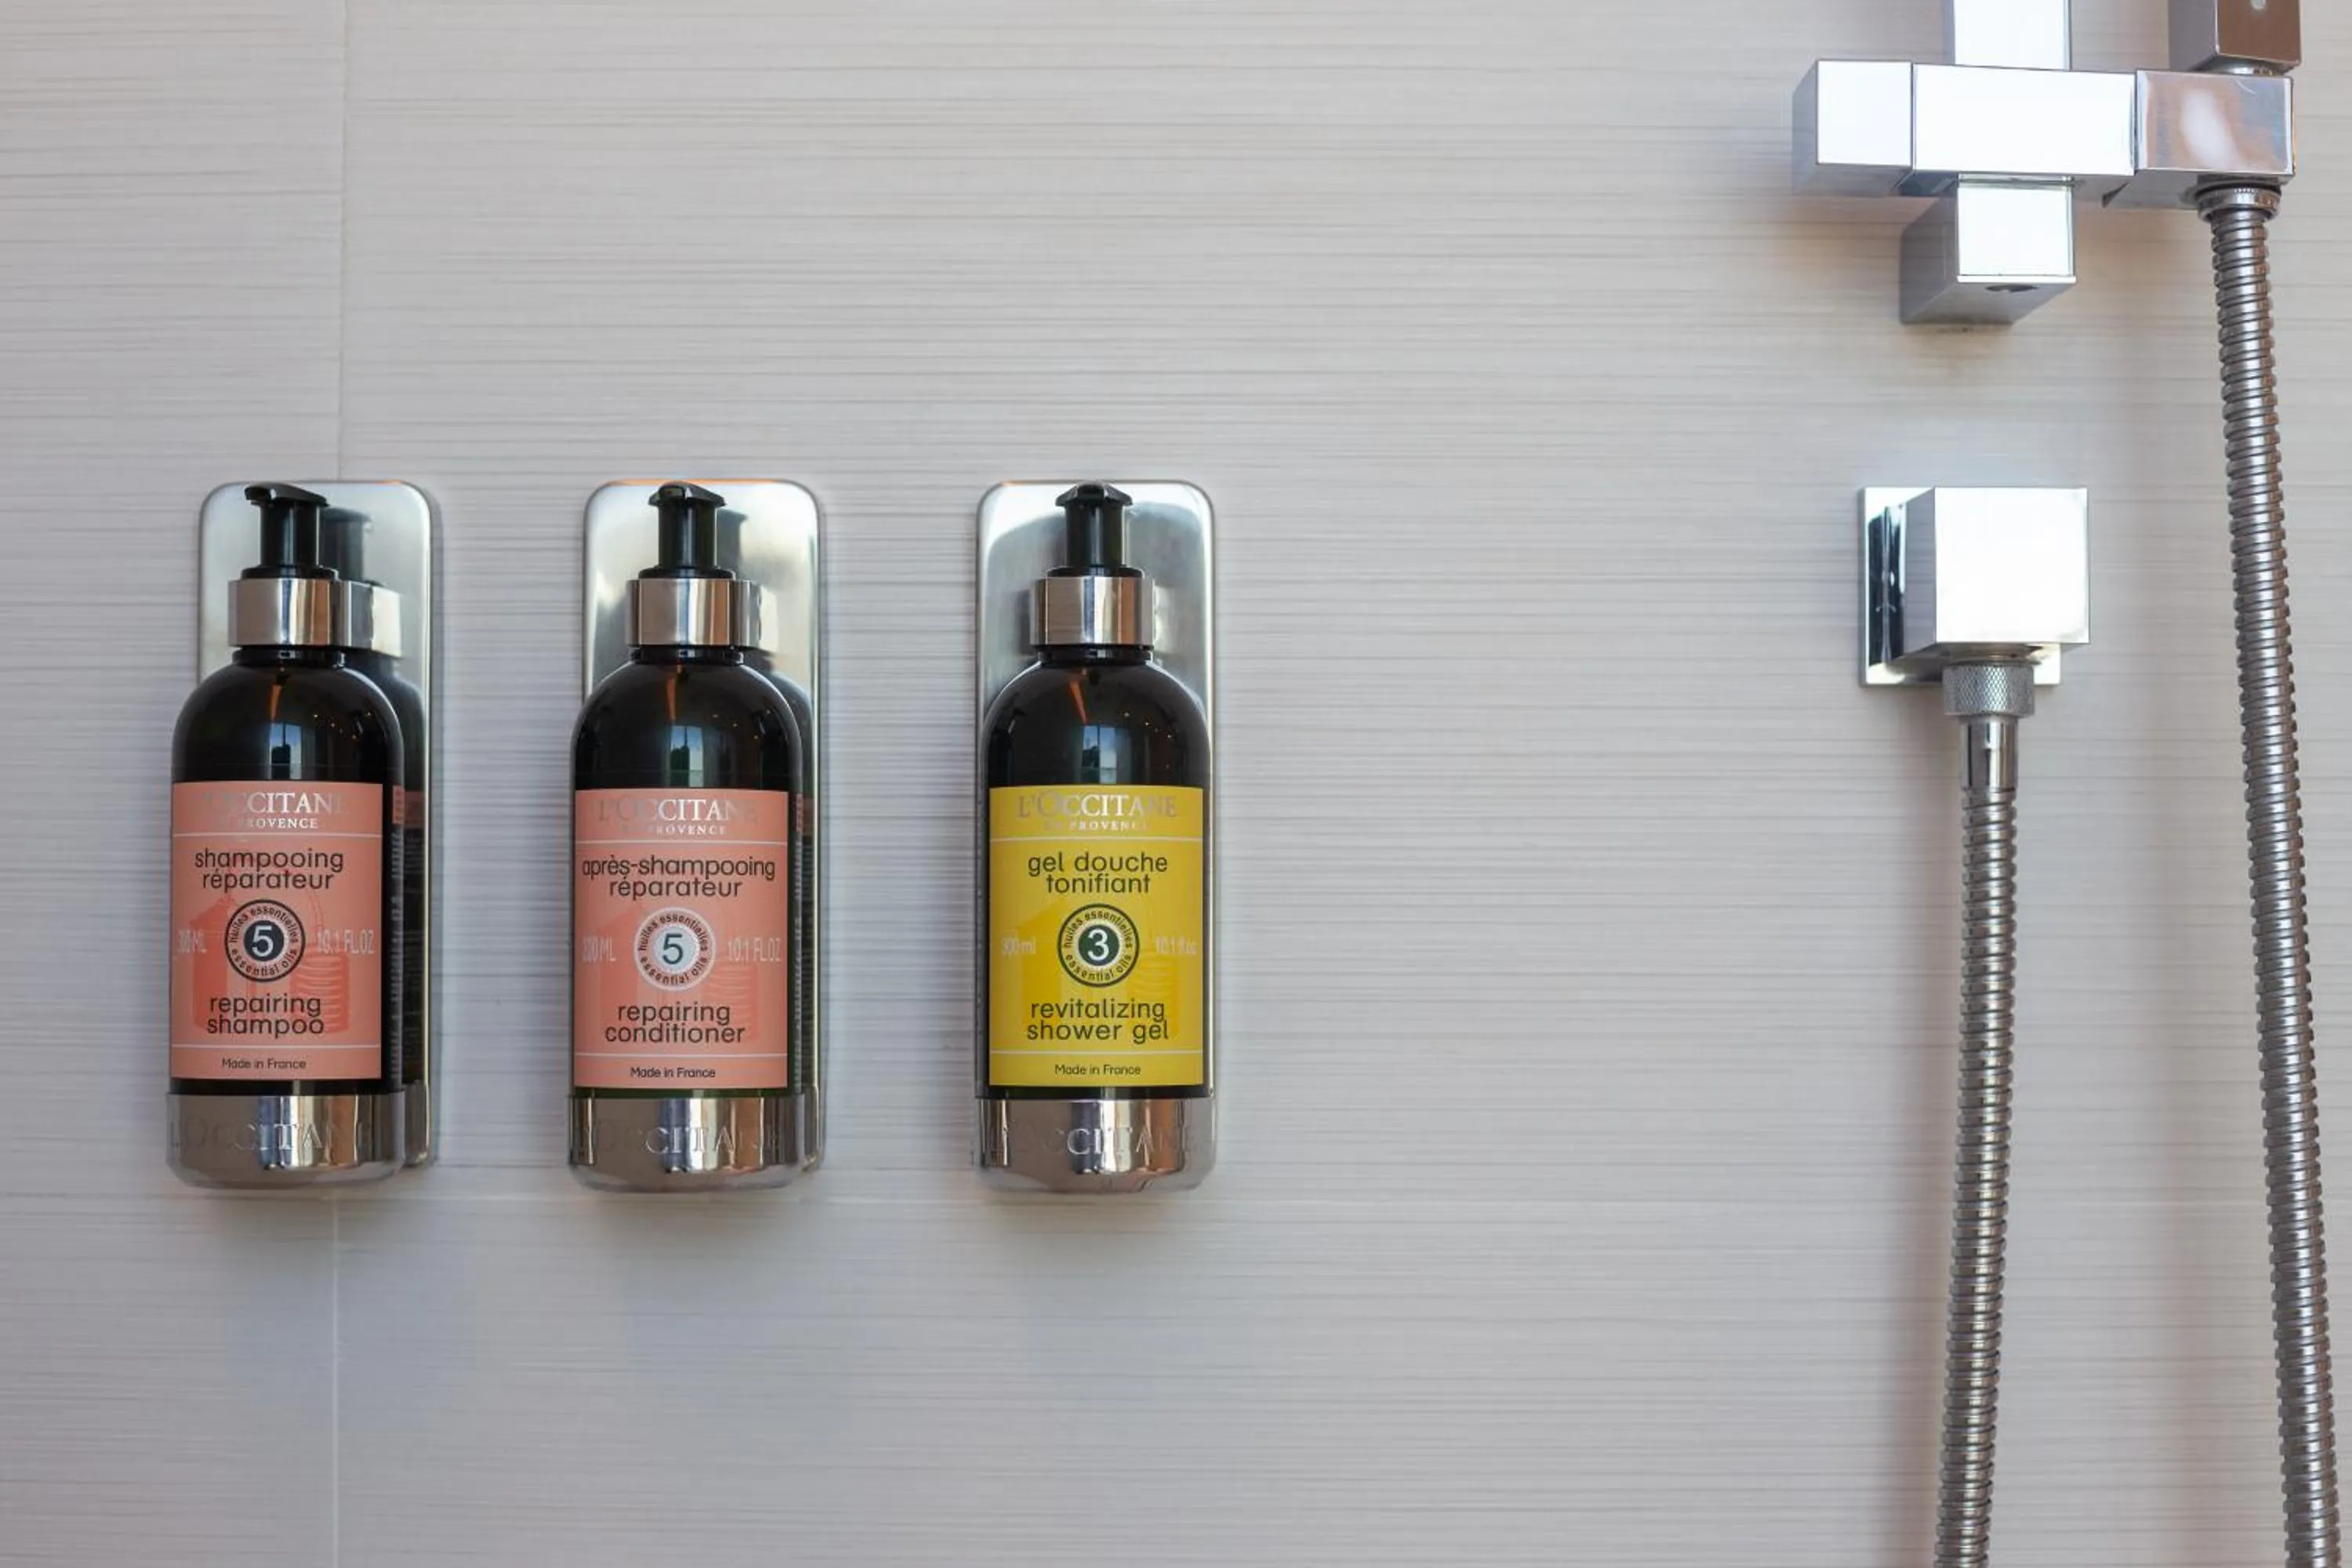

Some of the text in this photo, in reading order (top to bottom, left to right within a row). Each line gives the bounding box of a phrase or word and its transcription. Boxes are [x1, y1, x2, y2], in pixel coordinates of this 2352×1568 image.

[1018, 790, 1178, 818] L'OCCITANE
[238, 818, 318, 829] ROVENCE
[194, 848, 343, 873] shampooing
[582, 855, 776, 882] après-shampooing
[1028, 851, 1168, 877] gel douche
[202, 869, 335, 893] réparateur
[609, 874, 743, 901] réparateur
[1046, 873, 1152, 894] tonifiant
[252, 925, 274, 957] 5
[662, 933, 684, 965] 5
[1087, 928, 1109, 962] 3
[209, 993, 321, 1017] repairing
[617, 1001, 731, 1025] repairing
[1030, 998, 1165, 1022] revitalizing
[207, 1014, 325, 1039] shampoo
[604, 1022, 746, 1044] conditioner
[1027, 1019, 1169, 1044] shower gel
[221, 1058, 307, 1069] Made in France
[630, 1066, 716, 1078] Made in France
[1054, 1064, 1142, 1076] Made in France
